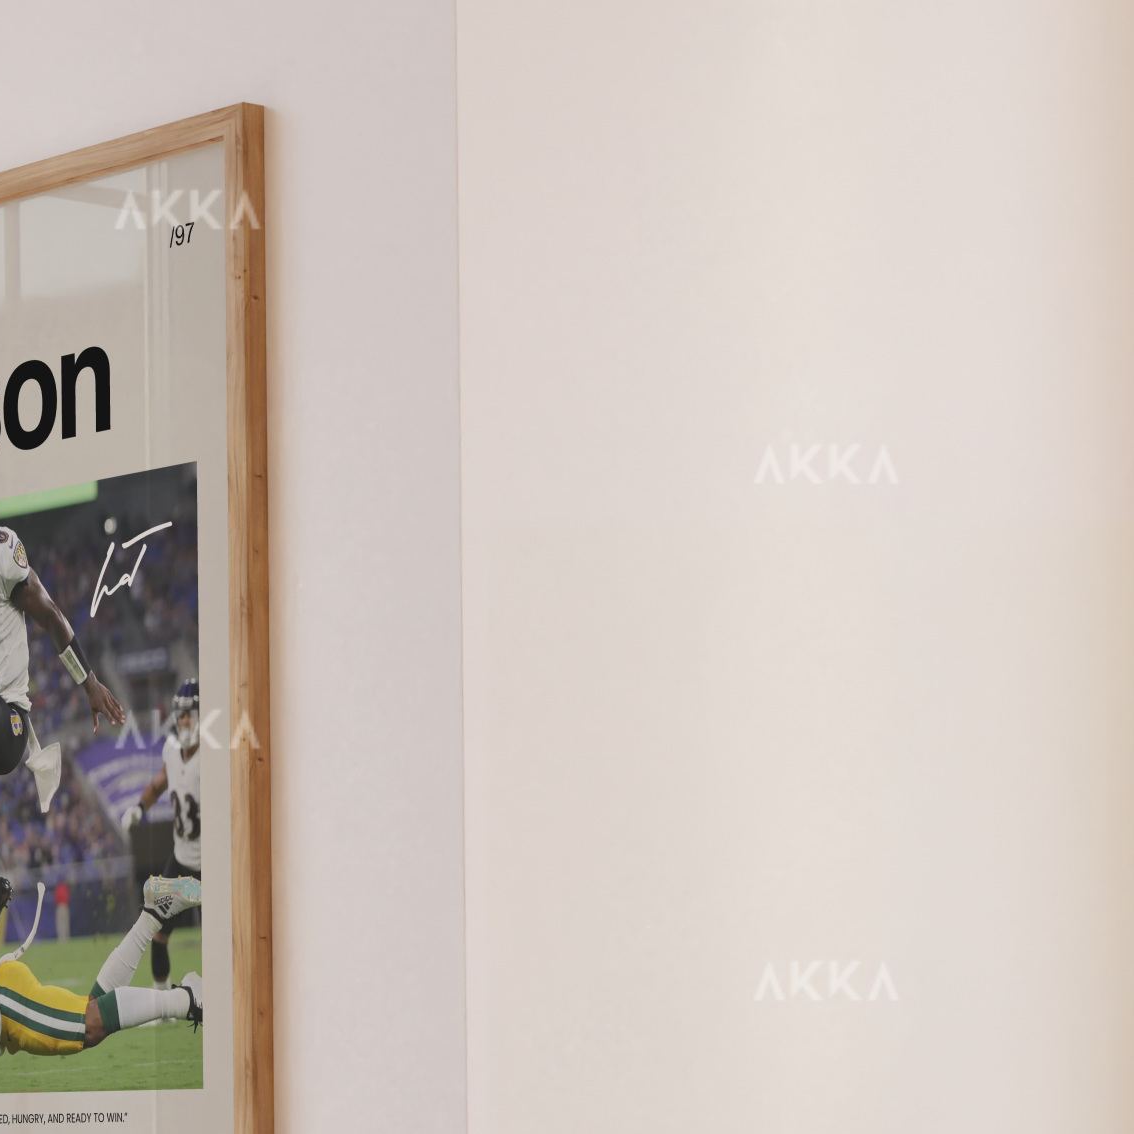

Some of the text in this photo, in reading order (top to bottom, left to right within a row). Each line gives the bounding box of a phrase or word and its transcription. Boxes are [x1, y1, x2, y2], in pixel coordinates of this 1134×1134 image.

[170, 222, 195, 249] /97
[12, 1114, 46, 1125] HUNGRY,
[48, 1114, 64, 1124] AND
[66, 1113, 91, 1123] READY
[94, 1113, 105, 1123] TO
